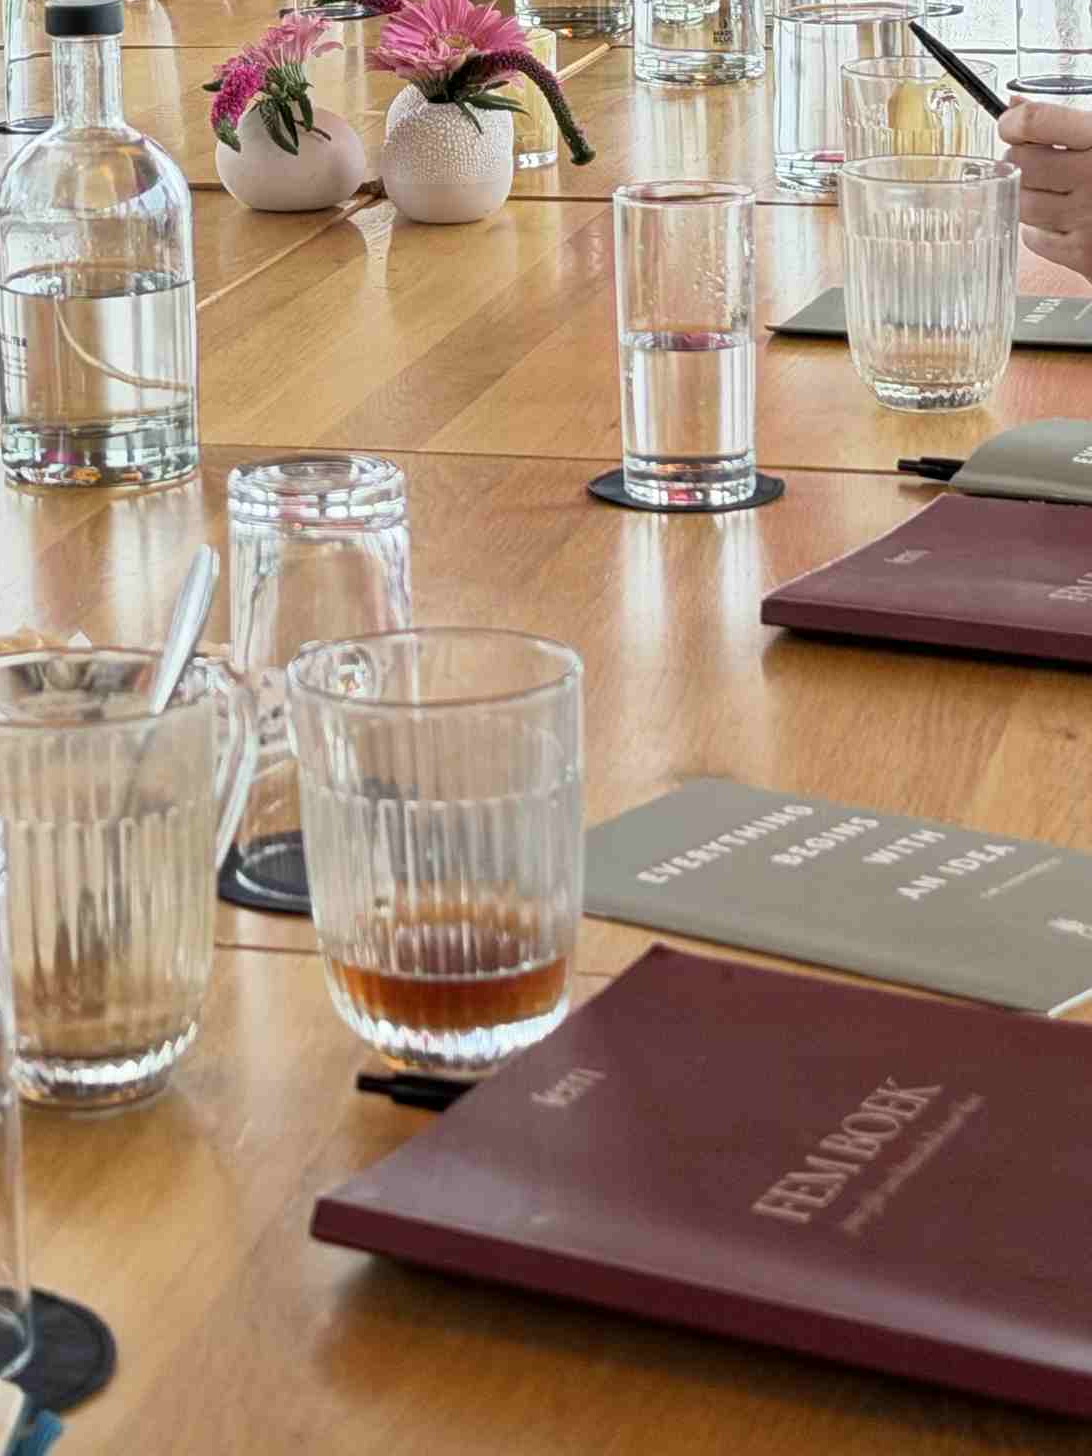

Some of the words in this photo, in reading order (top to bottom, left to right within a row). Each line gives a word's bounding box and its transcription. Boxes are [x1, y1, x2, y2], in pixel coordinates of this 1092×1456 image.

[636, 802, 815, 885] EVERYTHING
[770, 815, 881, 867] BEGINS
[862, 828, 947, 866] WITH
[896, 874, 948, 901] AN
[940, 842, 1018, 878] IDEA
[819, 1075, 944, 1161] BOEK
